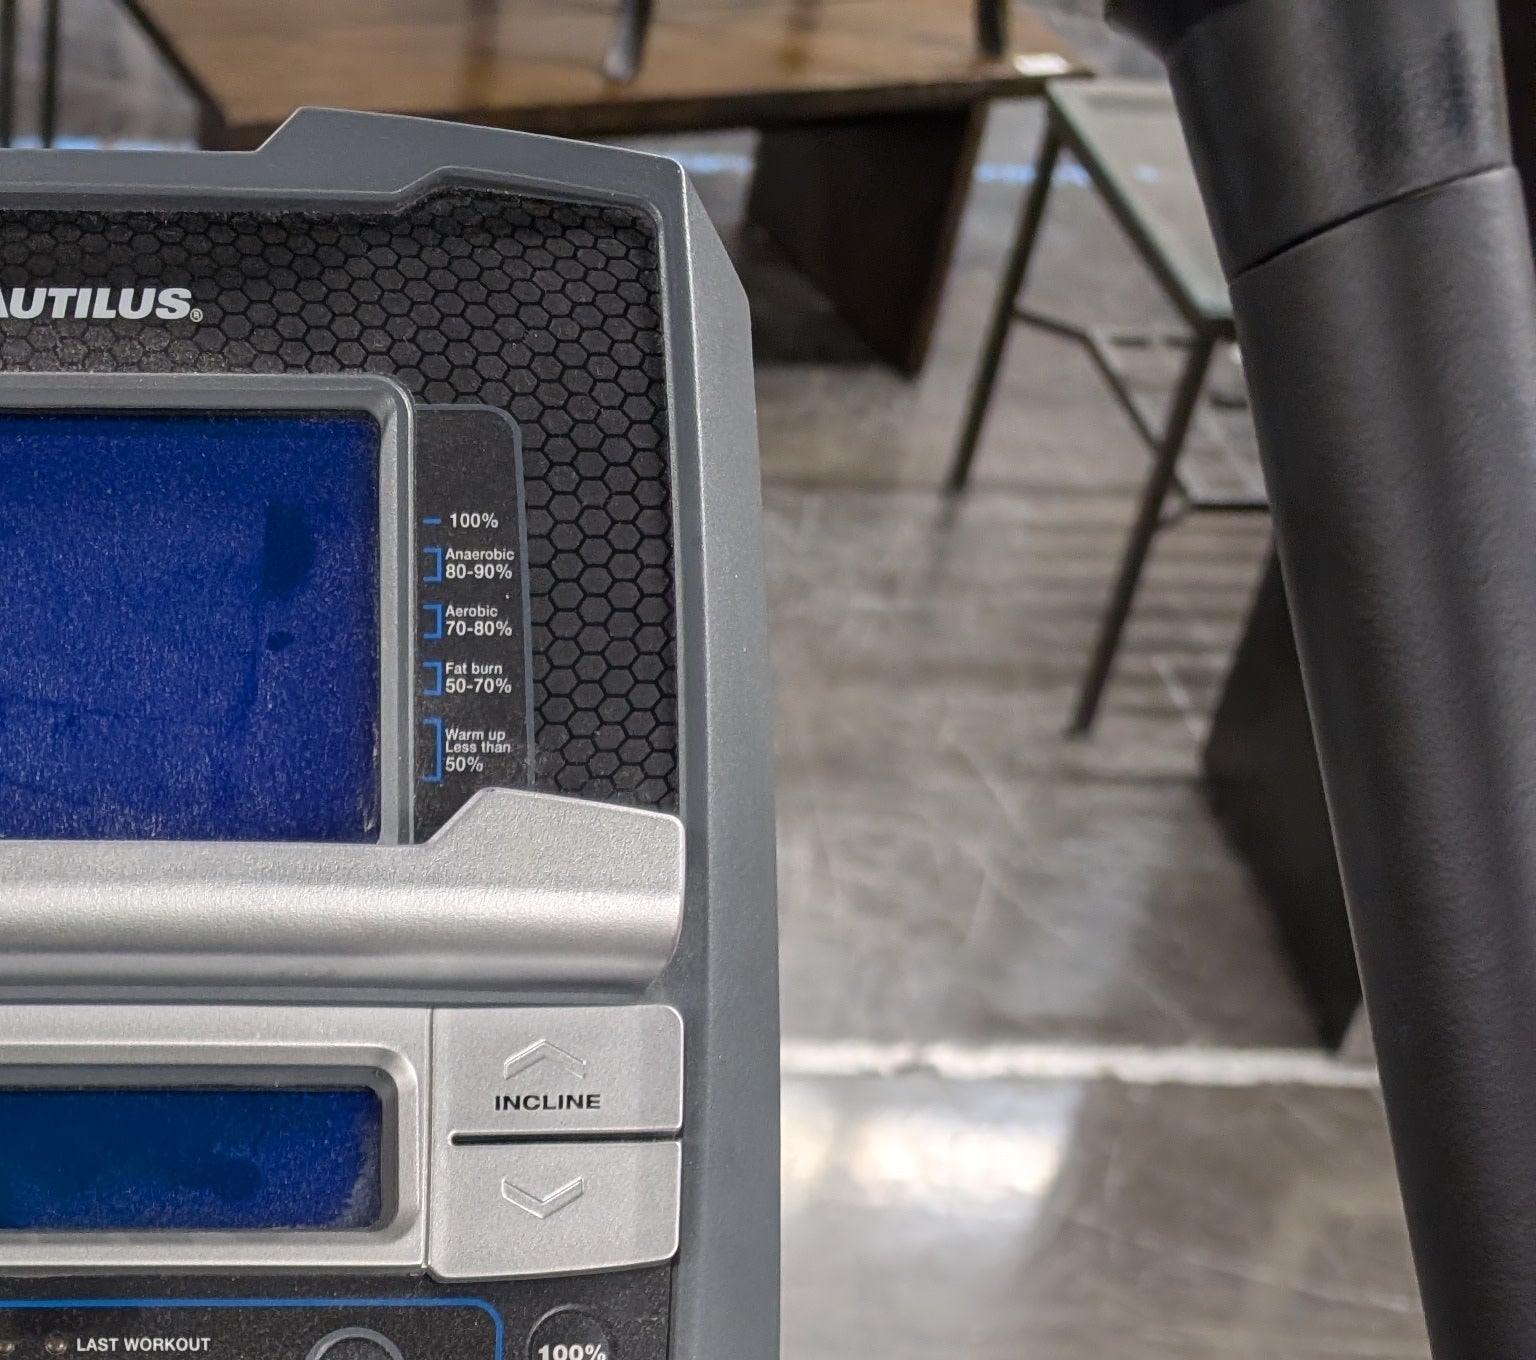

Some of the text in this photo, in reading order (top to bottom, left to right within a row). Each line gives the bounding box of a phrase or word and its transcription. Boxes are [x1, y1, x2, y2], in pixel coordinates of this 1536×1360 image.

[450, 512, 499, 529] 100%
[445, 547, 515, 561] Anaerobic
[445, 563, 513, 580] 80-90%
[445, 604, 498, 618] Aerobic
[445, 620, 513, 637] 70-80%
[445, 661, 503, 675] Fat burn
[445, 677, 512, 694] 50-70%
[445, 728, 506, 745] Warm up
[445, 740, 511, 754] Less than
[445, 755, 484, 772] 50%
[495, 1094, 601, 1111] INCLINE
[76, 1337, 211, 1352] LAST WORKOUT
